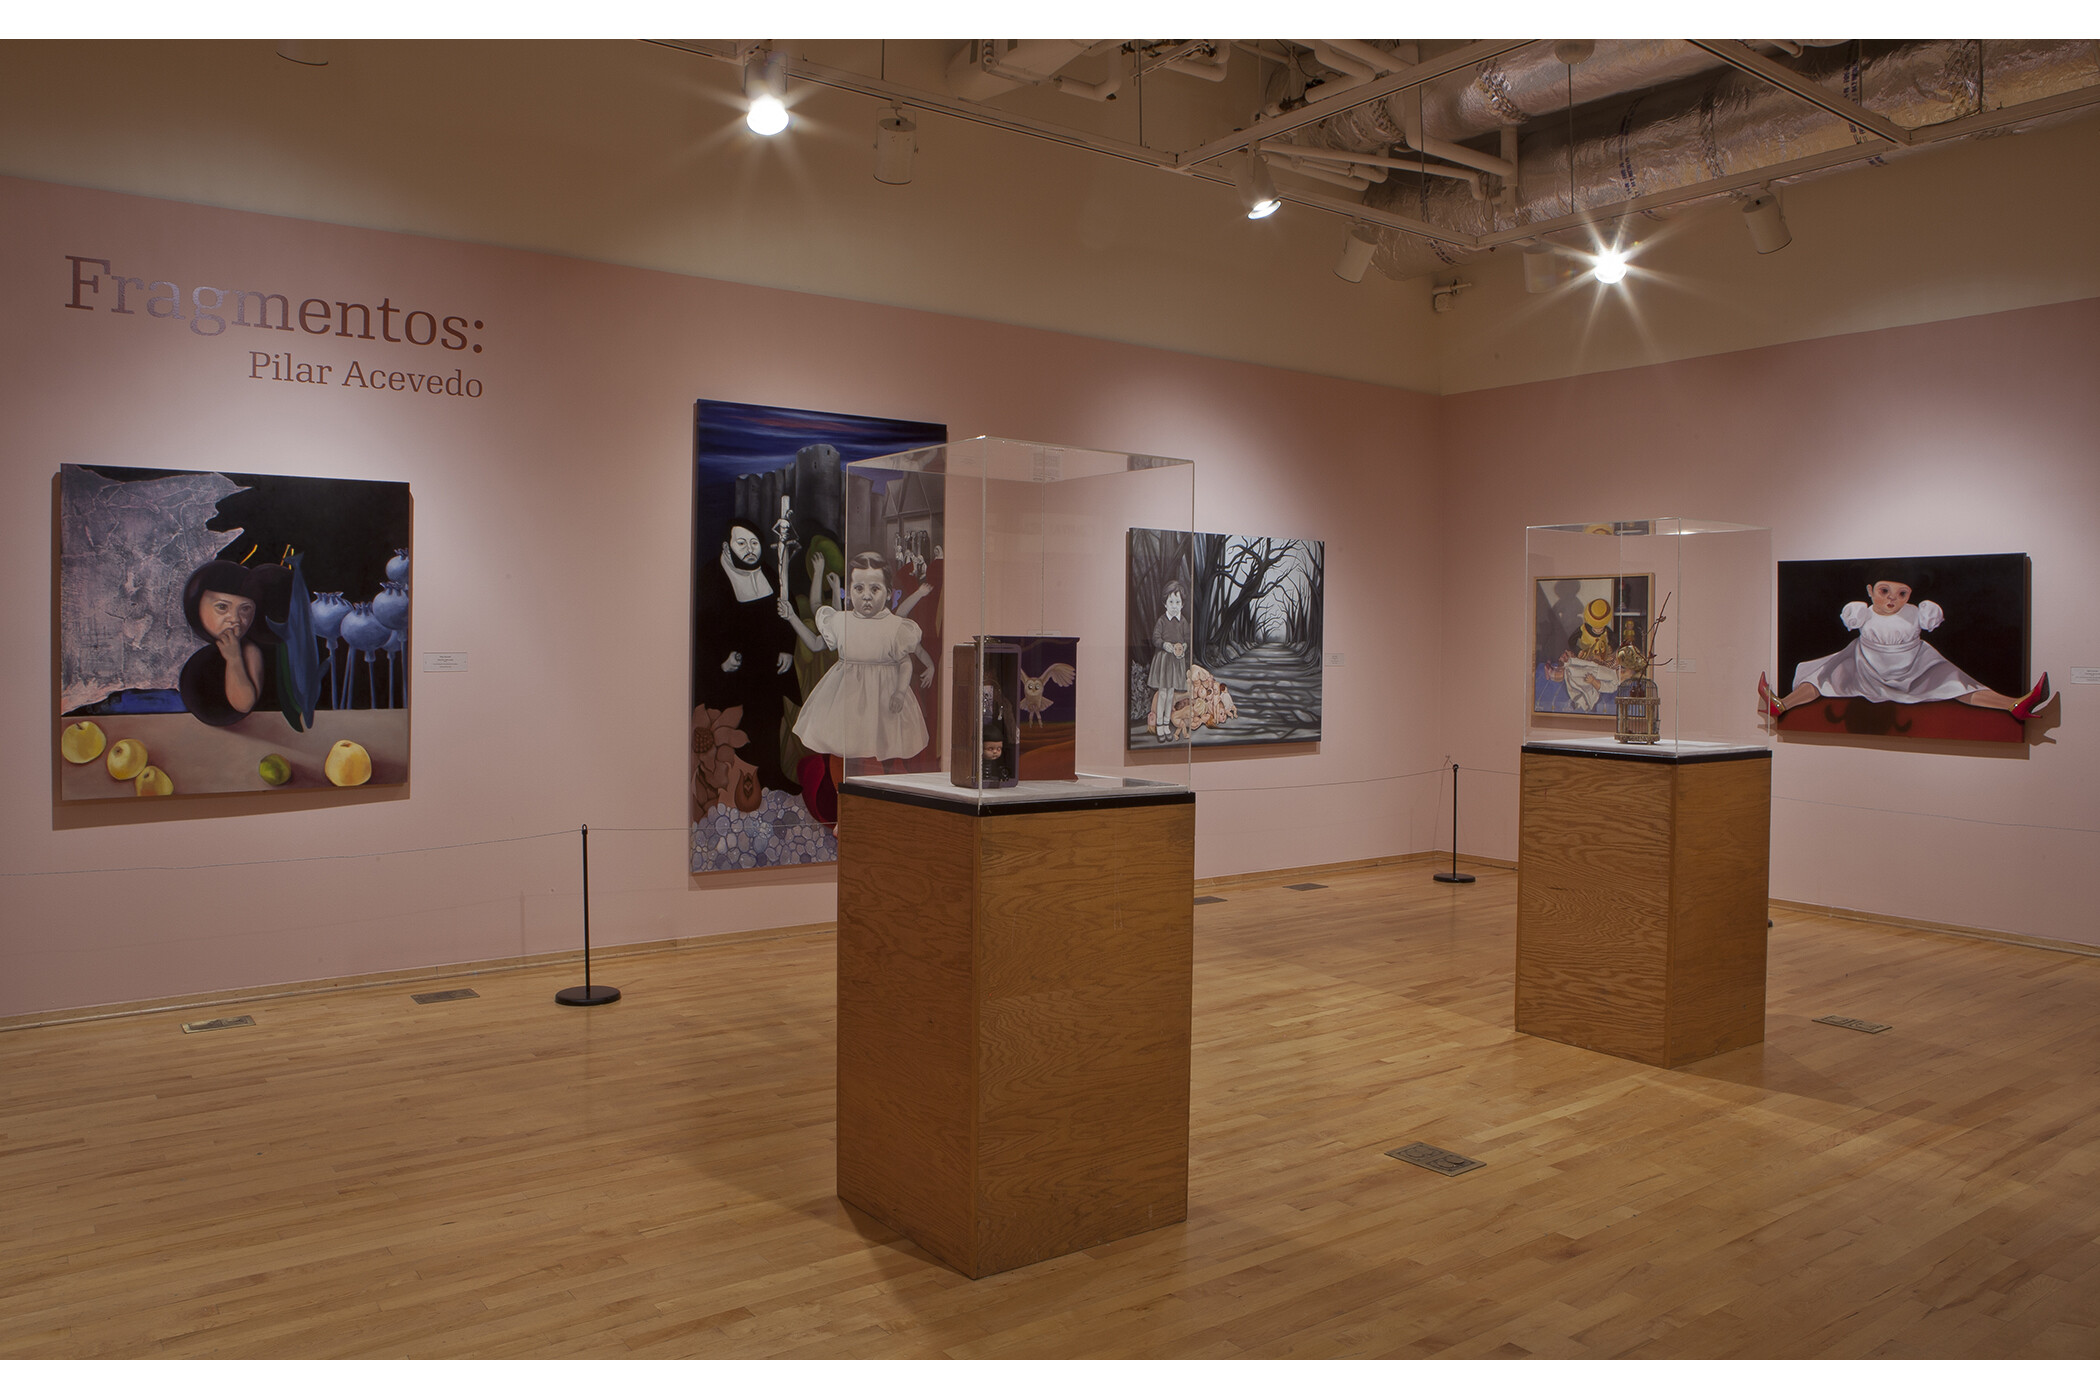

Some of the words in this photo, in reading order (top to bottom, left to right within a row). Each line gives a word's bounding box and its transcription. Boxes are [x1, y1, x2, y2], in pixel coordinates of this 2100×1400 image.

[64, 255, 485, 354] Fragmentos:
[248, 350, 333, 385] Pilar
[341, 361, 484, 398] Acevedo
